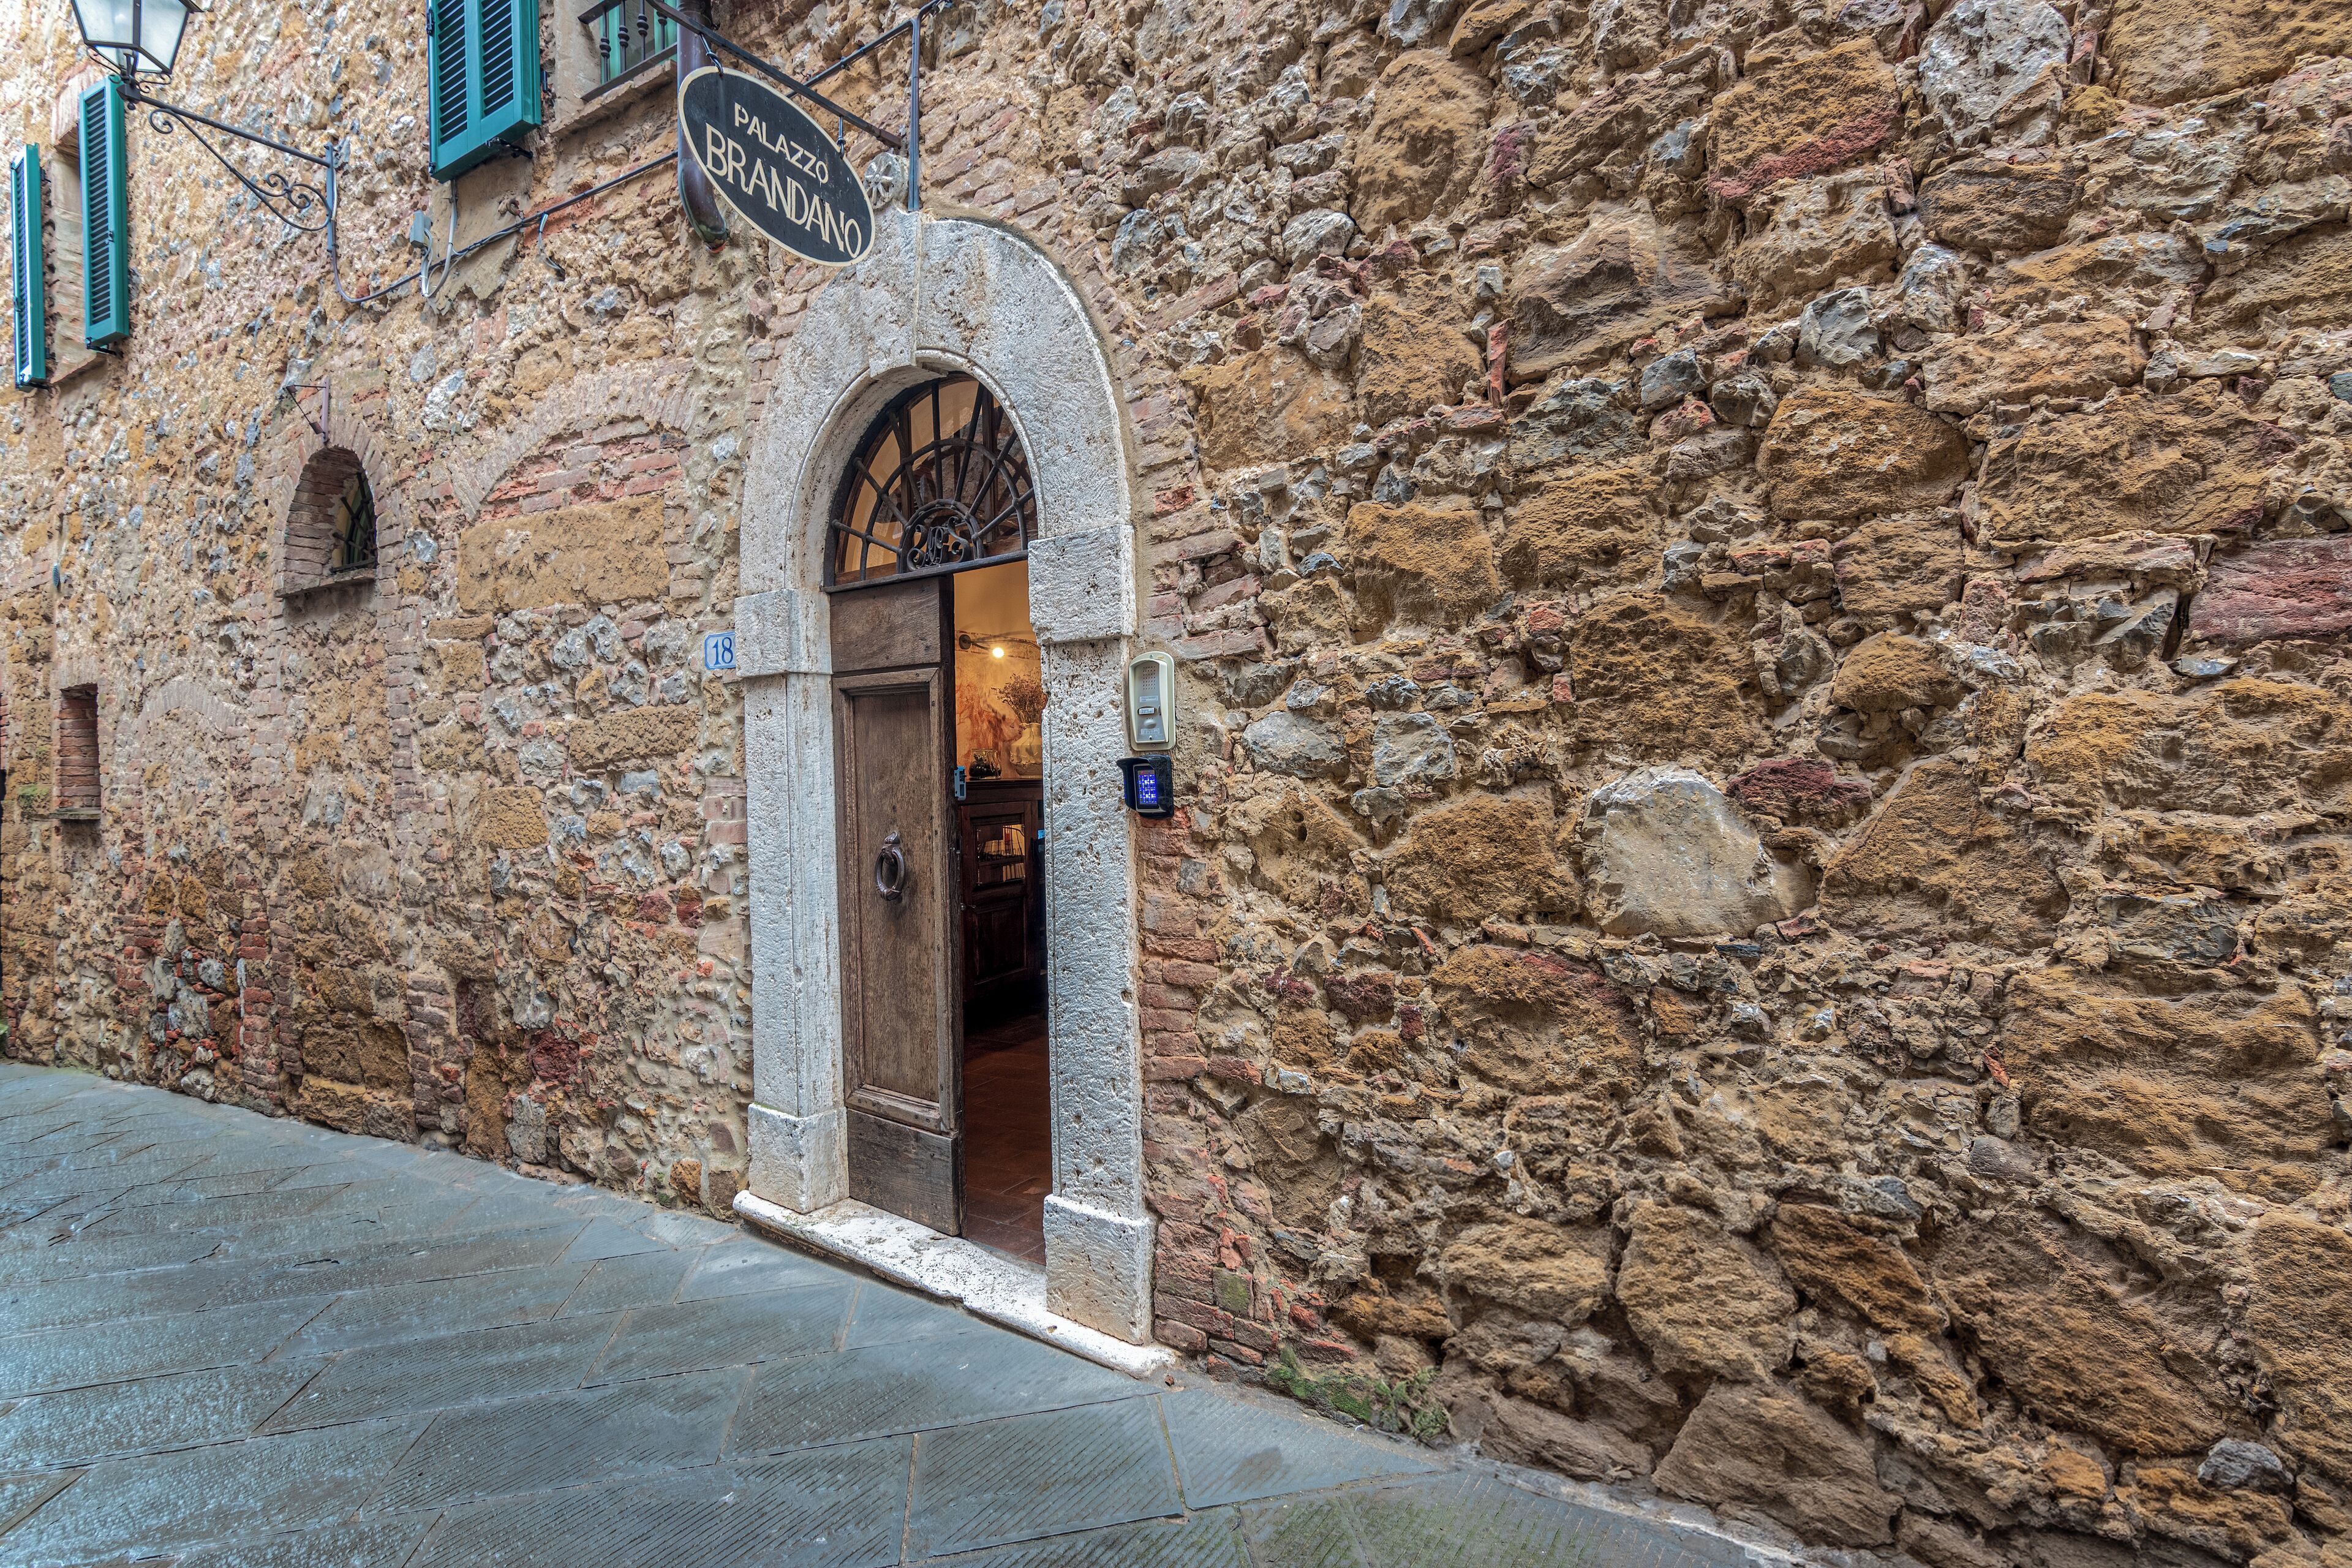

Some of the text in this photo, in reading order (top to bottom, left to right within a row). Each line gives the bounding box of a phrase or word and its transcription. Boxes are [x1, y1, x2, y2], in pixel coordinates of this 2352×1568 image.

[735, 102, 829, 184] PALAZZO
[706, 123, 862, 258] BRANDANO
[712, 637, 733, 666] 18
